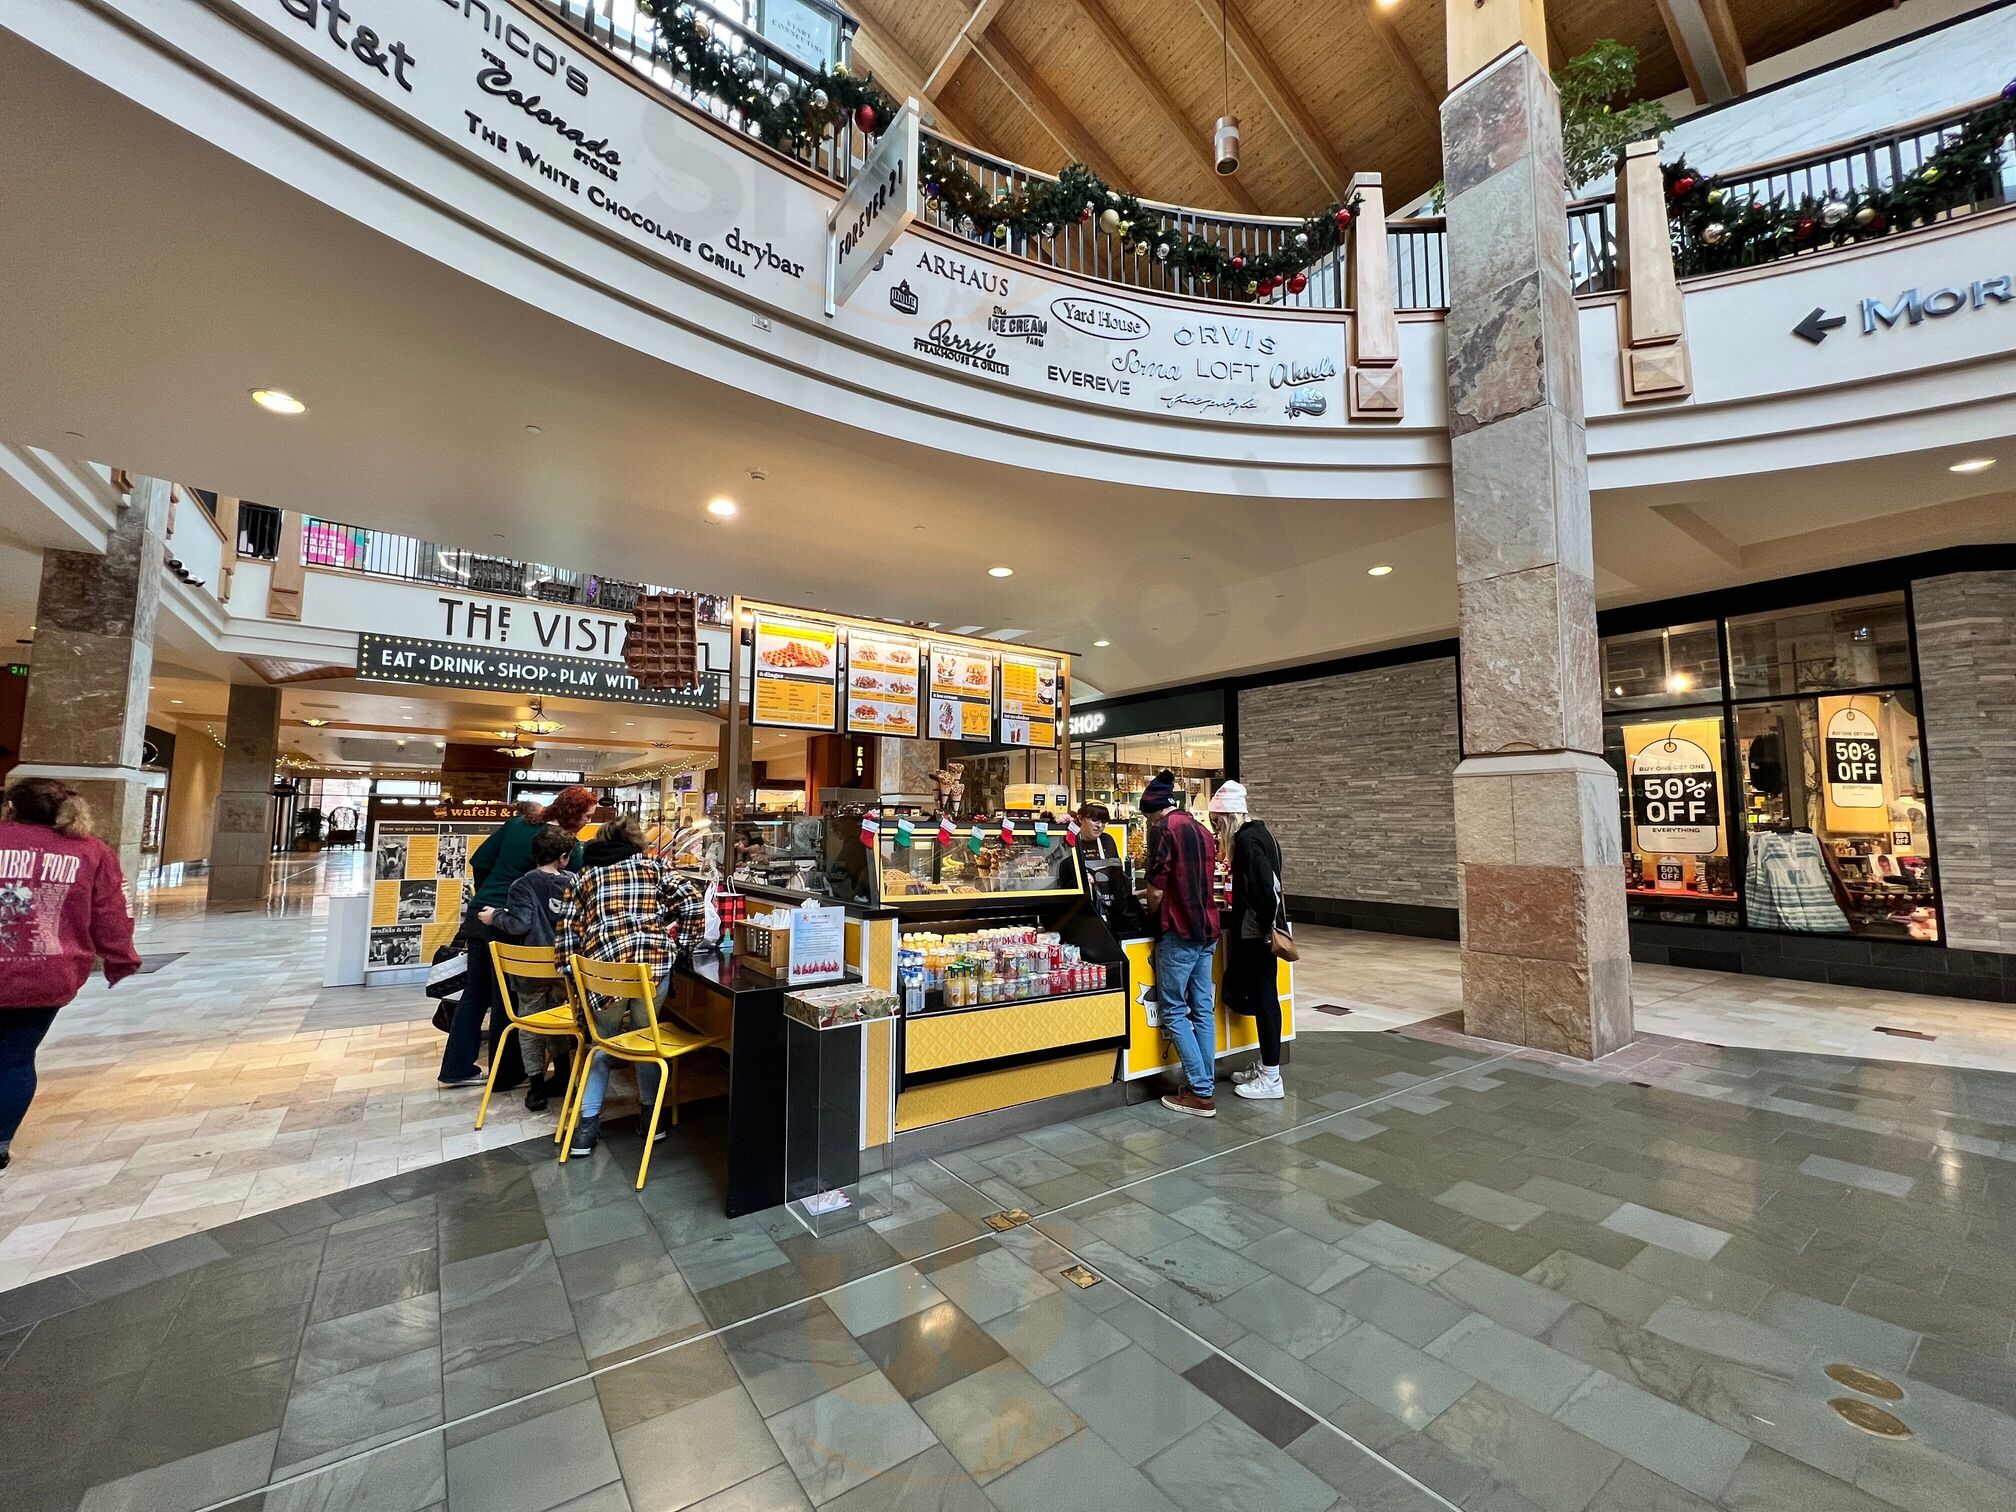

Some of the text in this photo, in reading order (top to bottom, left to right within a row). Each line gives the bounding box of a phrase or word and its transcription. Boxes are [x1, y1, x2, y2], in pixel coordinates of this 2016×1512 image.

[477, 67, 622, 165] Colorado
[573, 148, 619, 182] STORE
[464, 109, 746, 278] THE WHITE CHOCOLATE GRILL
[838, 184, 886, 265] FOREVER
[888, 158, 904, 198] 21
[725, 227, 805, 279] drybar
[916, 251, 1009, 297] ARHAUS
[988, 317, 1048, 335] ICE CREAM
[1062, 302, 1141, 333] Yard House
[913, 340, 970, 366] STEAKHOUSE
[928, 318, 997, 359] Perry's
[1174, 325, 1278, 355] ORVIS
[1048, 365, 1131, 396] EVEREVE
[1112, 349, 1183, 381] Soma
[1196, 358, 1260, 382] LOFT
[438, 597, 627, 656] THE VIST
[381, 650, 415, 668] EAT
[429, 655, 485, 676] DRINK
[498, 662, 548, 681] SHOP
[560, 669, 598, 687] PLAY
[1069, 713, 1105, 735] SHOP
[1835, 742, 1876, 761] 50%
[527, 771, 580, 782] INFORMATION
[1838, 762, 1877, 781] OFF
[1644, 778, 1706, 800] 50%
[450, 806, 497, 817] wafels
[500, 808, 511, 818] &
[1646, 801, 1706, 822] OFF
